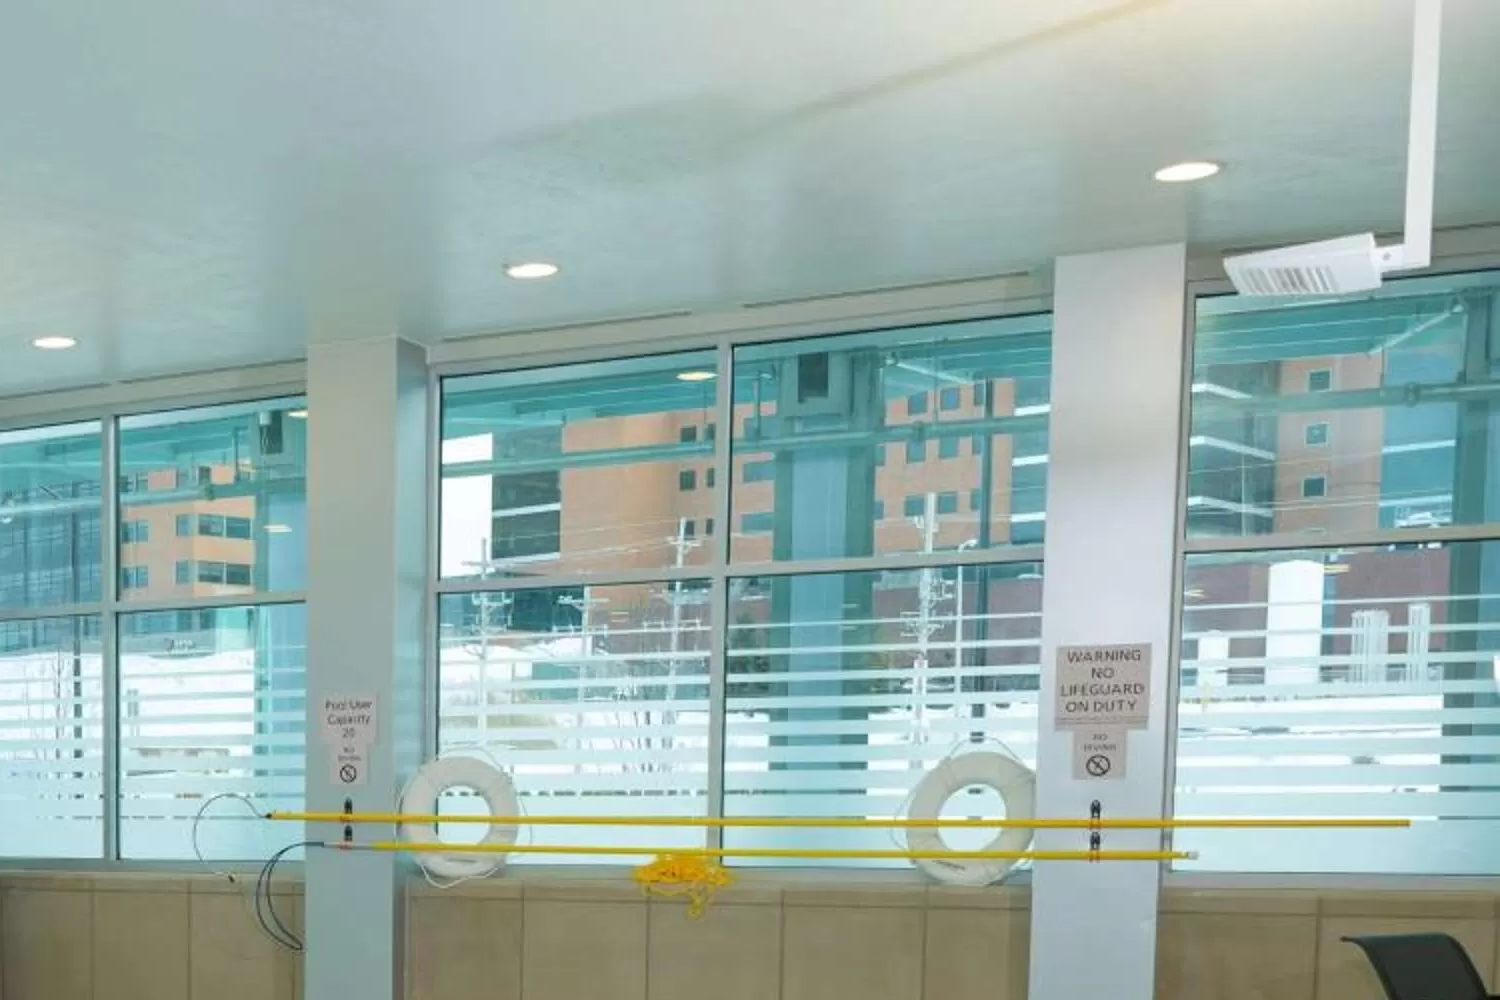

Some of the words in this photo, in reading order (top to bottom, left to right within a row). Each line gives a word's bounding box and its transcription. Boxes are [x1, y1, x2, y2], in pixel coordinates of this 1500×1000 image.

[1067, 649, 1142, 664] WARNING
[1091, 667, 1115, 679] NO
[1060, 683, 1145, 697] LIFEGUARD
[1065, 700, 1089, 712] ON
[1093, 699, 1138, 713] DUTY
[327, 714, 371, 725] Capacity
